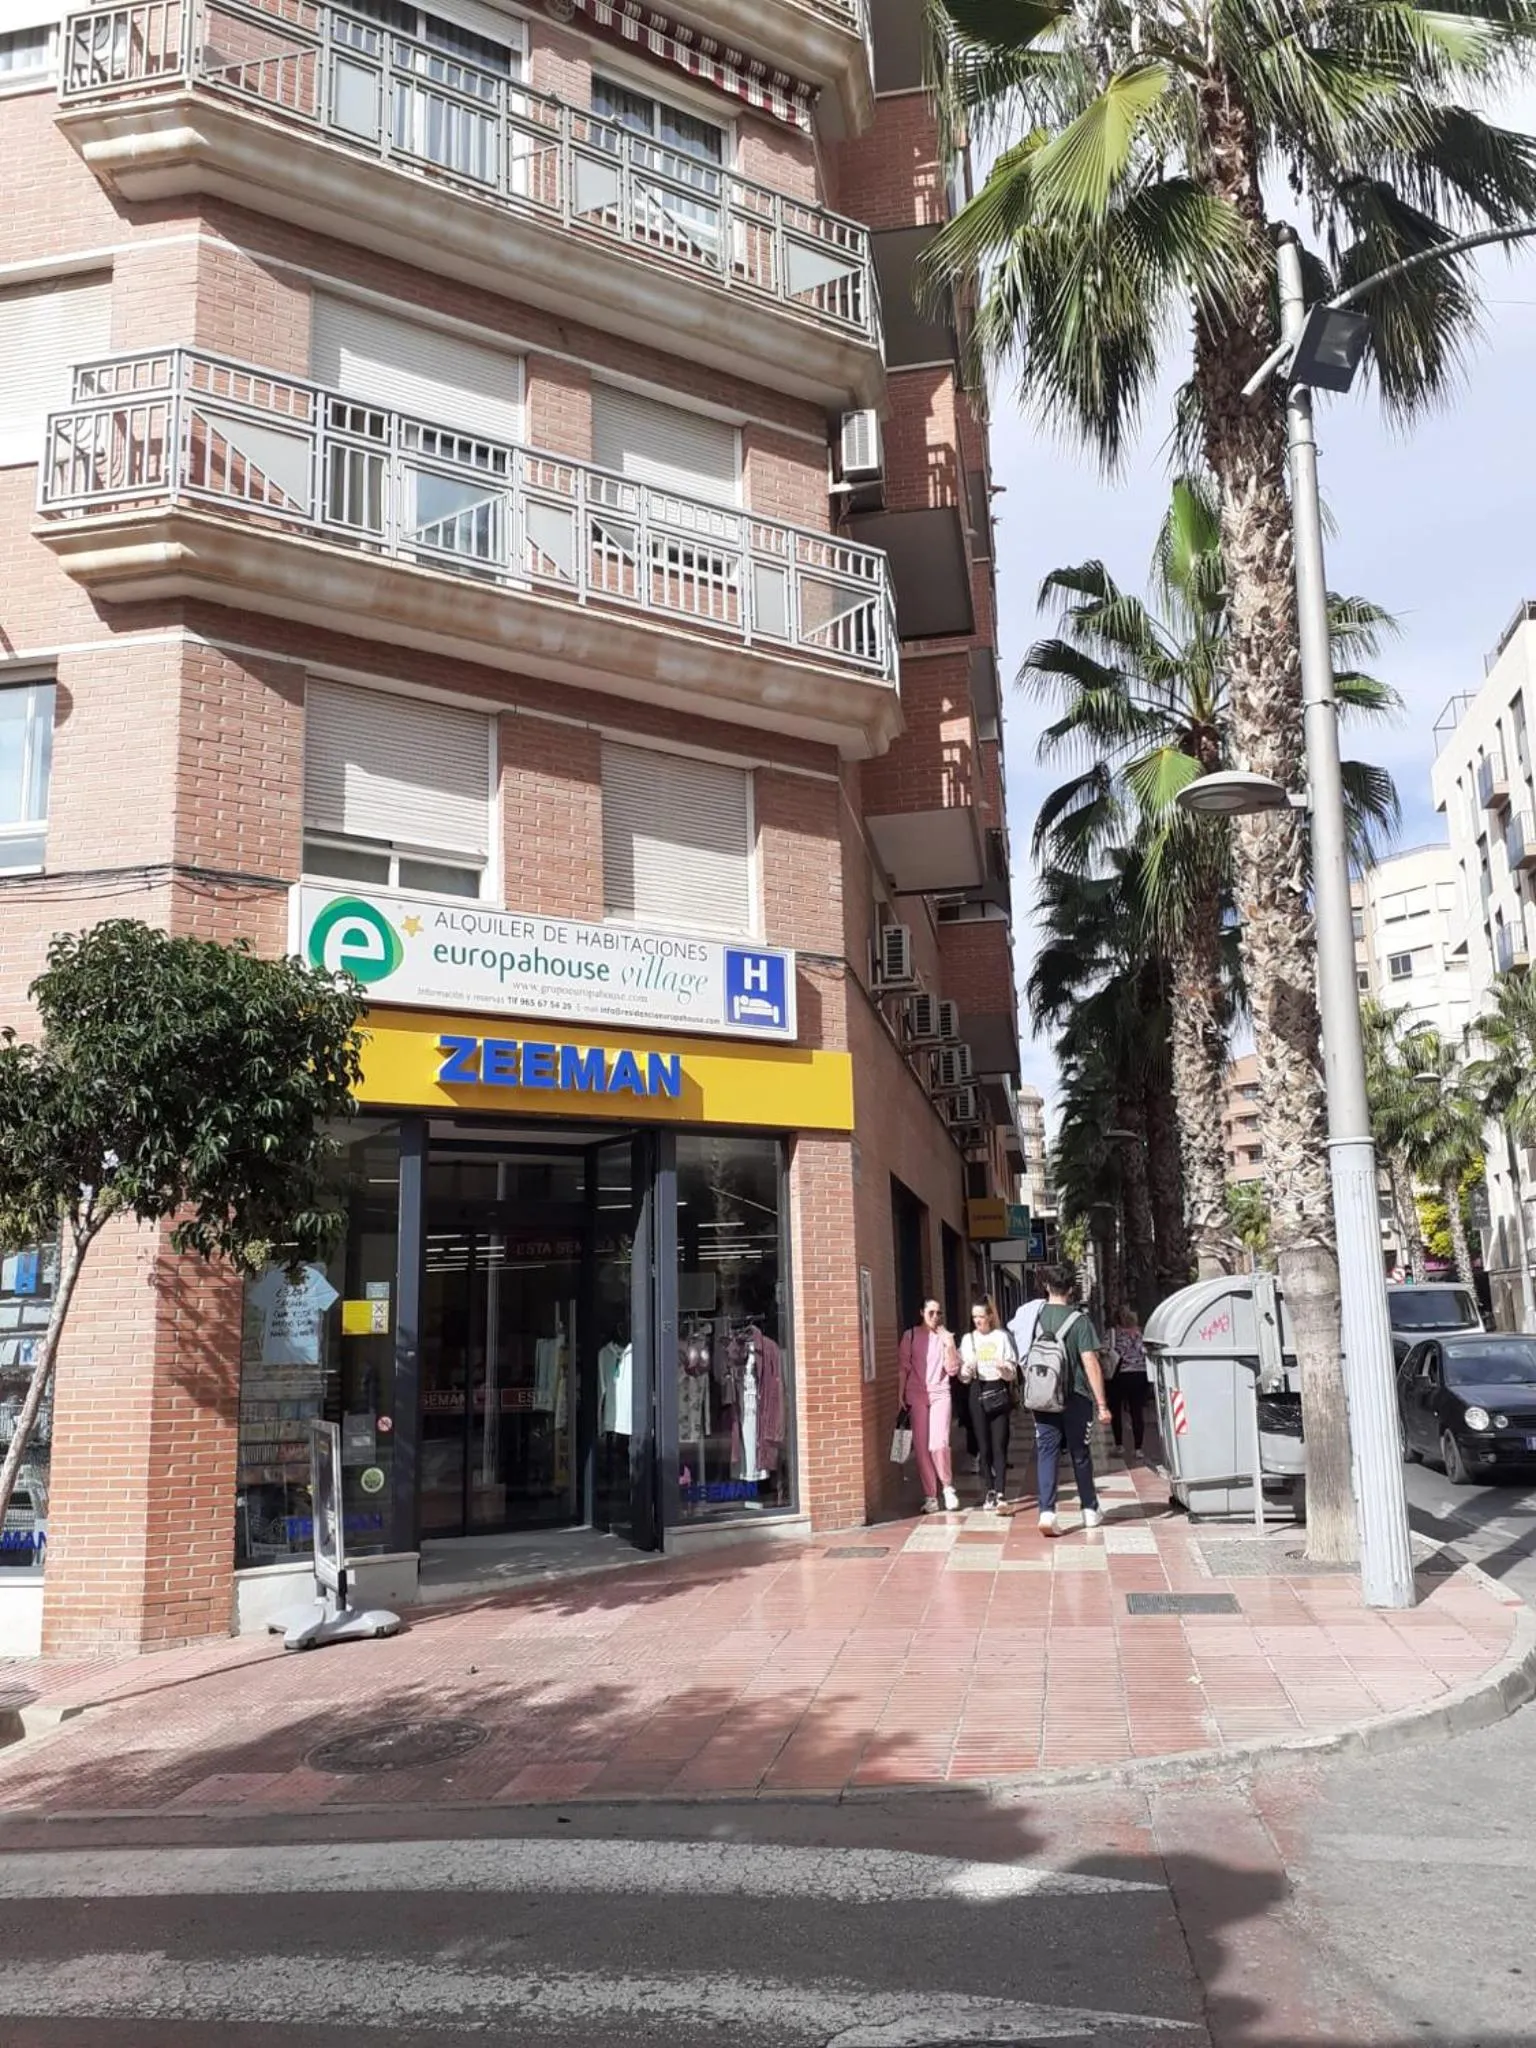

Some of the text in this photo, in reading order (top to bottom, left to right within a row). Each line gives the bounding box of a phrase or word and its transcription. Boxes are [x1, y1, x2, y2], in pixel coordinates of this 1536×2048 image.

[434, 911, 708, 962] ALQUILER DE HABITACIONES
[433, 942, 709, 1005] europahouse village
[743, 957, 768, 992] H
[520, 997, 535, 1007] 965
[537, 1000, 548, 1008] 67
[436, 1034, 682, 1098] ZEEMAN
